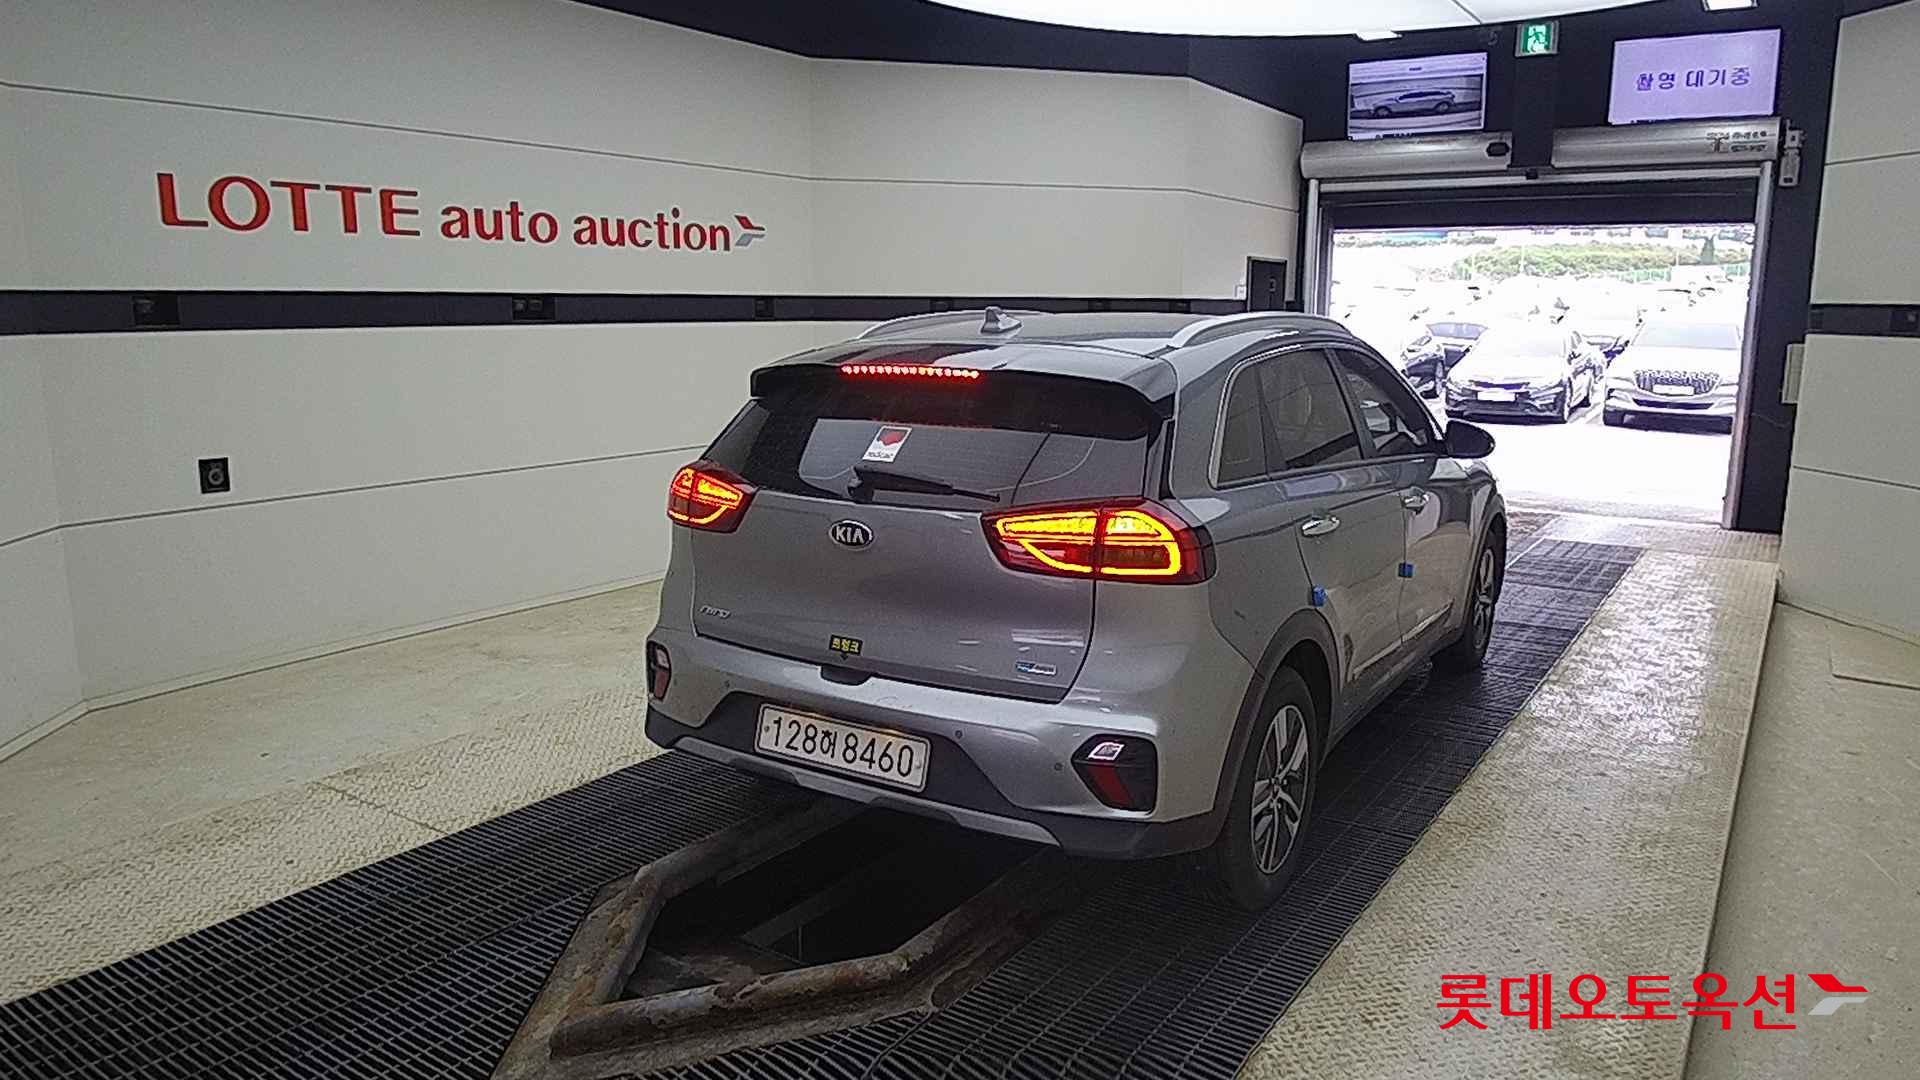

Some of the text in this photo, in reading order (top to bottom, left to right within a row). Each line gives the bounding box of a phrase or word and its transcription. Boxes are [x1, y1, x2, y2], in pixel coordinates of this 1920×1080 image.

[1685, 66, 1750, 88] 대기중
[156, 172, 731, 252] LOTTE auto auction
[836, 525, 865, 544] KIA
